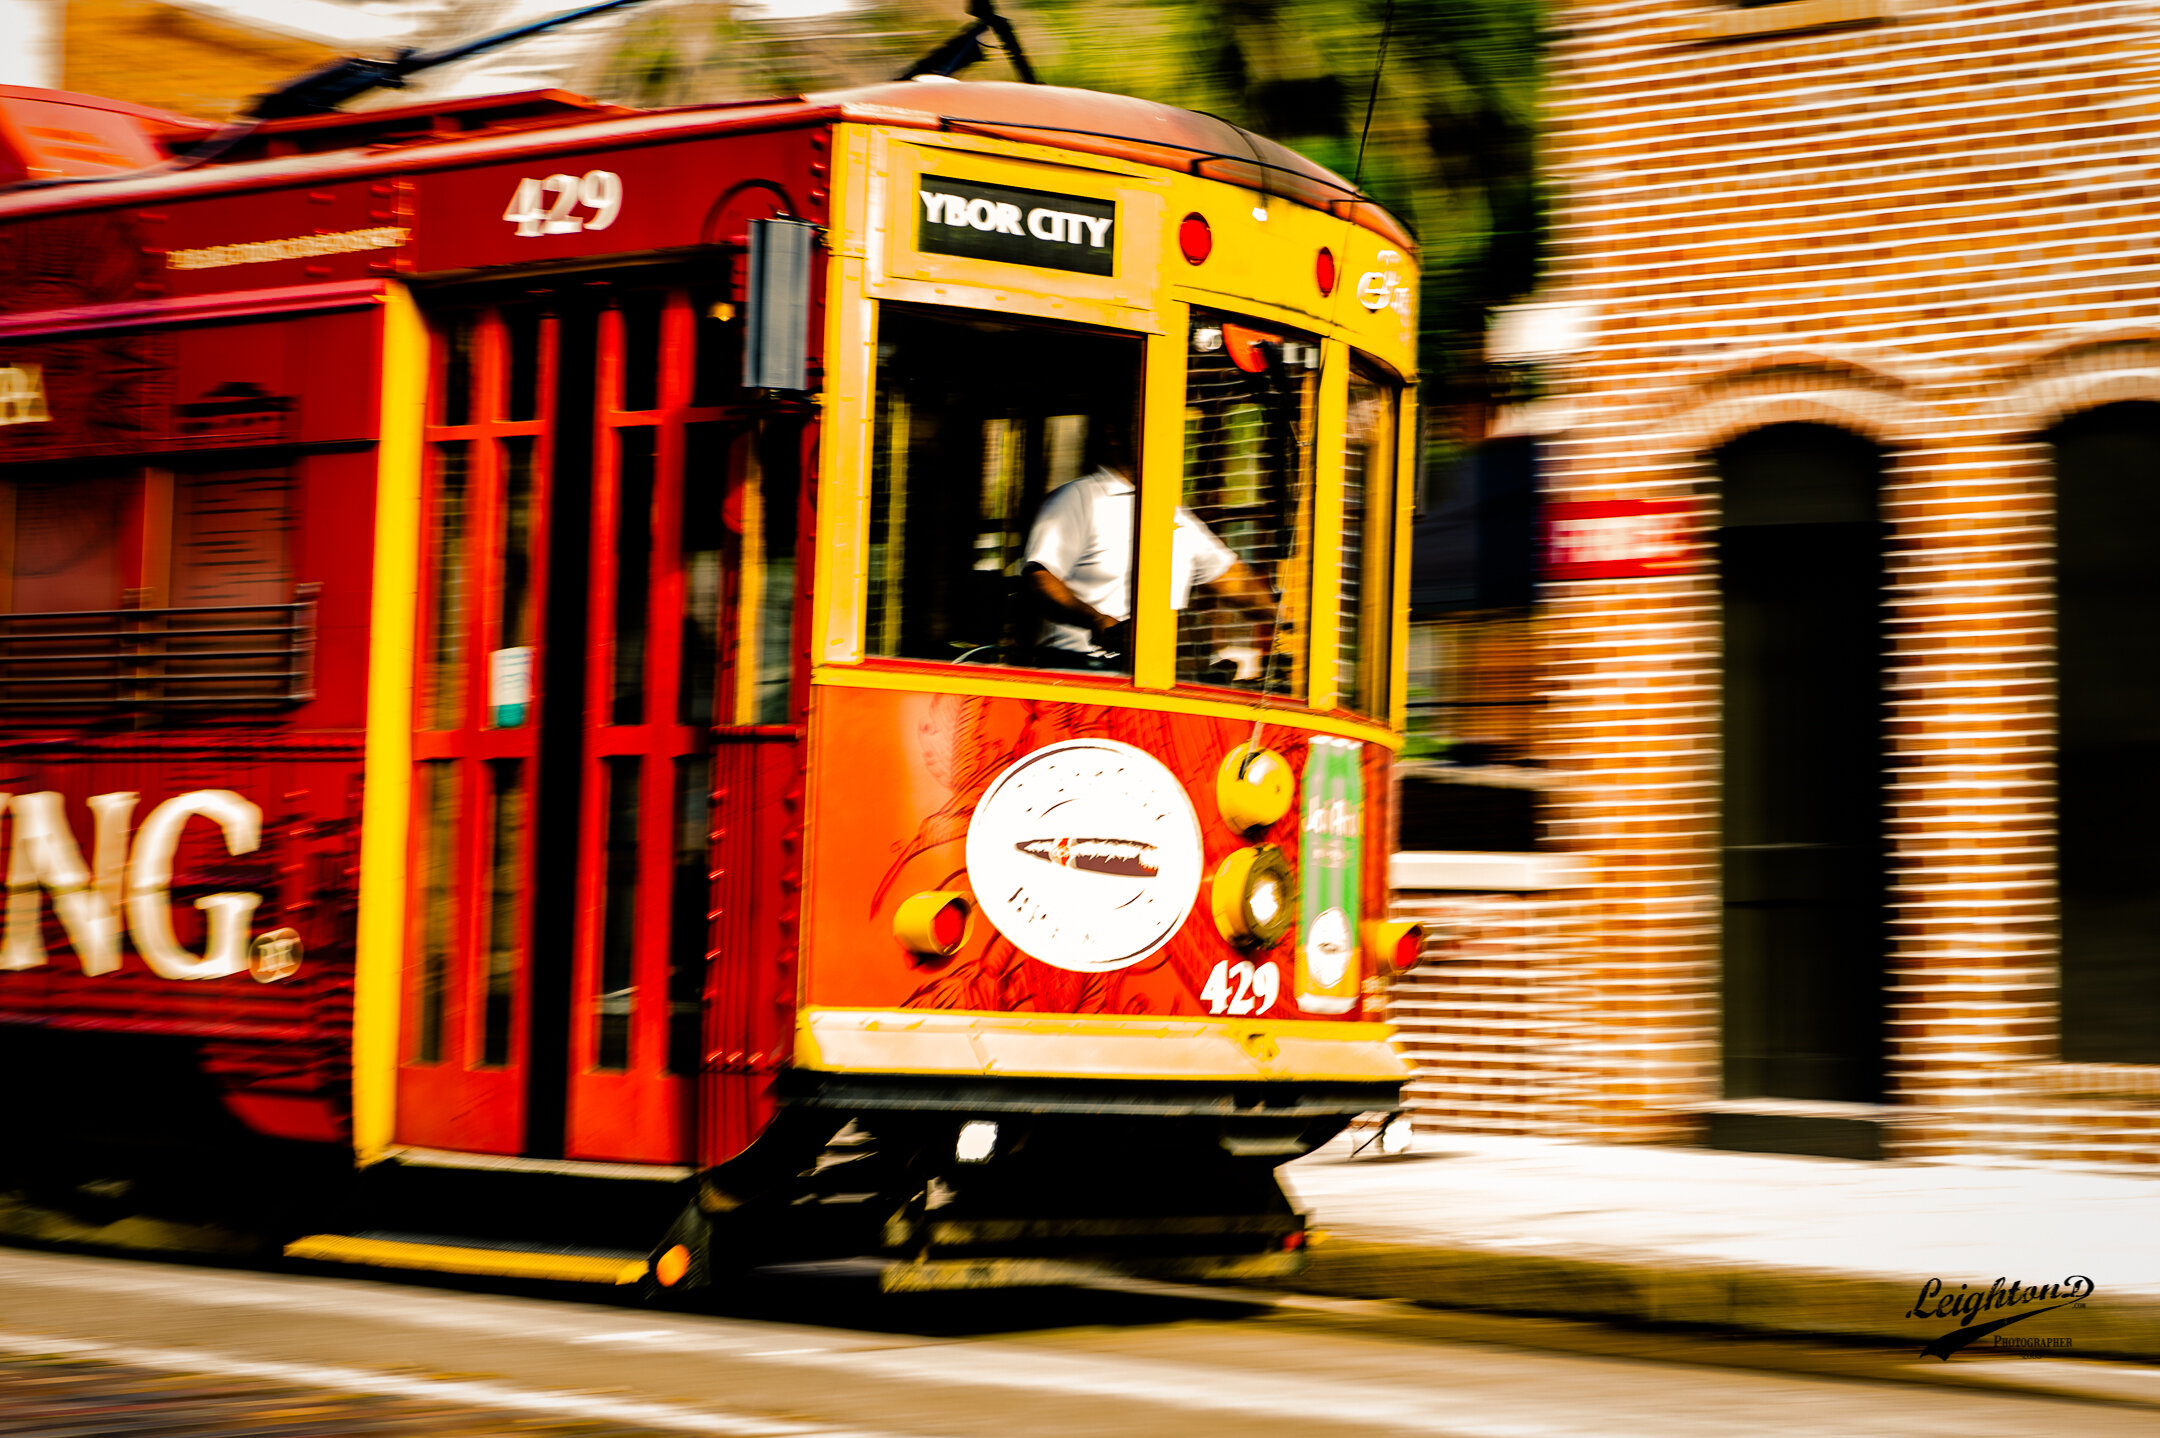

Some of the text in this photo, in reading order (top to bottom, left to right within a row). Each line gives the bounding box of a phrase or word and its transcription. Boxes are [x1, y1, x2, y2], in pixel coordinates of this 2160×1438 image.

[502, 169, 623, 237] 429
[918, 190, 1114, 248] YBOR CITY
[1200, 959, 1280, 1016] 429
